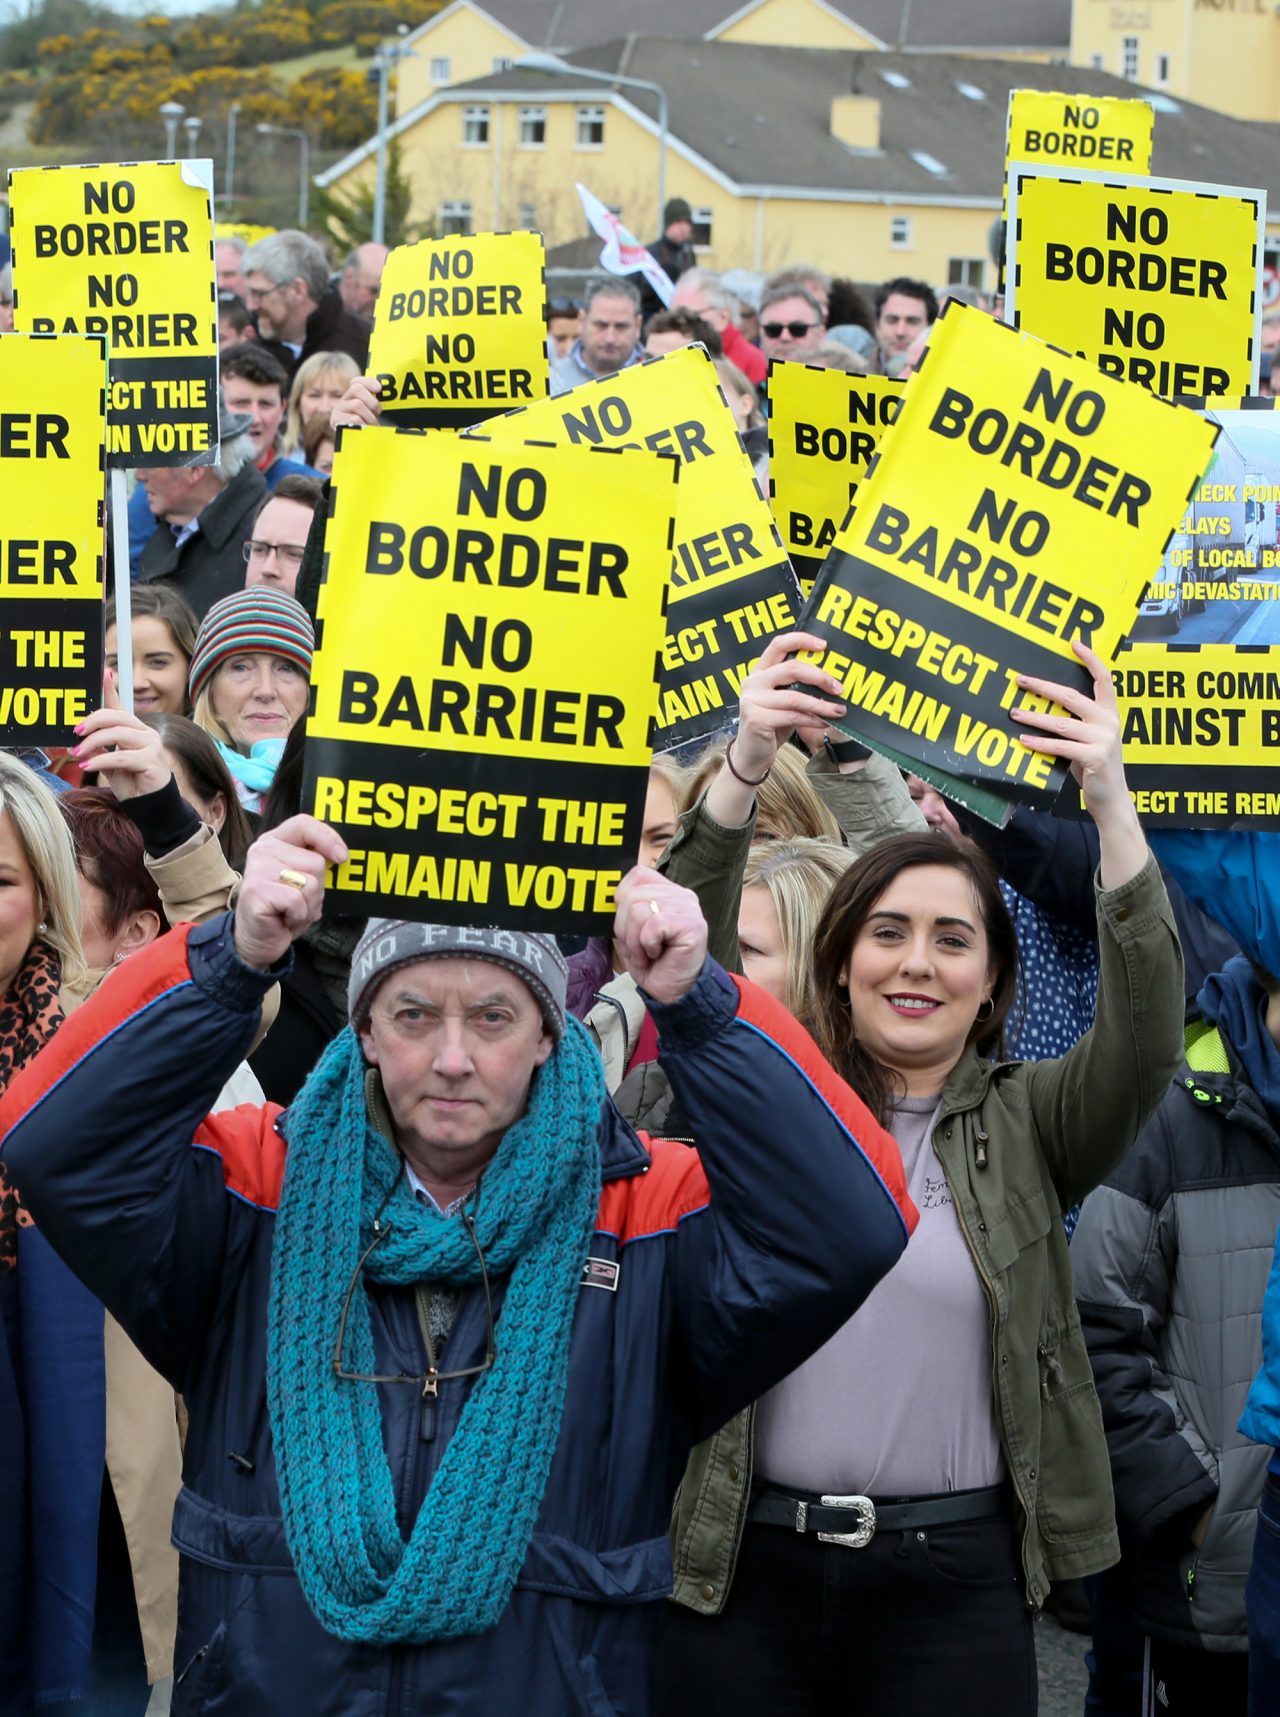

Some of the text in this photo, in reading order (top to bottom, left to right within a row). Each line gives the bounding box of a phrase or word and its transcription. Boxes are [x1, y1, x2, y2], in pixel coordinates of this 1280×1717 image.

[1063, 104, 1099, 130] NO
[1024, 130, 1135, 161] BORDER
[83, 180, 136, 215] NO
[34, 219, 191, 259] BORDER
[1106, 203, 1168, 246] NO
[428, 250, 474, 281] NO
[1045, 242, 1228, 301] BORDER
[87, 273, 139, 309] NO
[388, 285, 523, 322] BORDER
[425, 333, 475, 365] NO
[1103, 308, 1166, 351] NO
[151, 379, 207, 409] THE
[376, 368, 534, 403] BARRIER
[1023, 366, 1106, 437] NO
[136, 422, 210, 453] VOTE
[561, 395, 633, 445] NO
[928, 386, 1153, 529] BORDER
[456, 461, 548, 523] NO
[967, 486, 1051, 558] NO
[1176, 516, 1232, 536] ELAYS
[364, 520, 629, 599] BORDER
[865, 503, 1105, 650] BARRIER
[1169, 549, 1194, 568] OF
[1198, 549, 1257, 568] LOCAL
[722, 592, 797, 645] THE
[815, 583, 999, 696] RESPECT
[9, 629, 86, 669] THE
[440, 612, 534, 674] NO
[337, 669, 627, 751] BARRIER
[1122, 707, 1246, 747] AINST
[953, 712, 1057, 790] VOTE
[313, 776, 628, 847] RESPECT THE
[1184, 791, 1228, 815] THE
[504, 862, 623, 914] VOTE
[360, 924, 543, 981] NO FEAR
